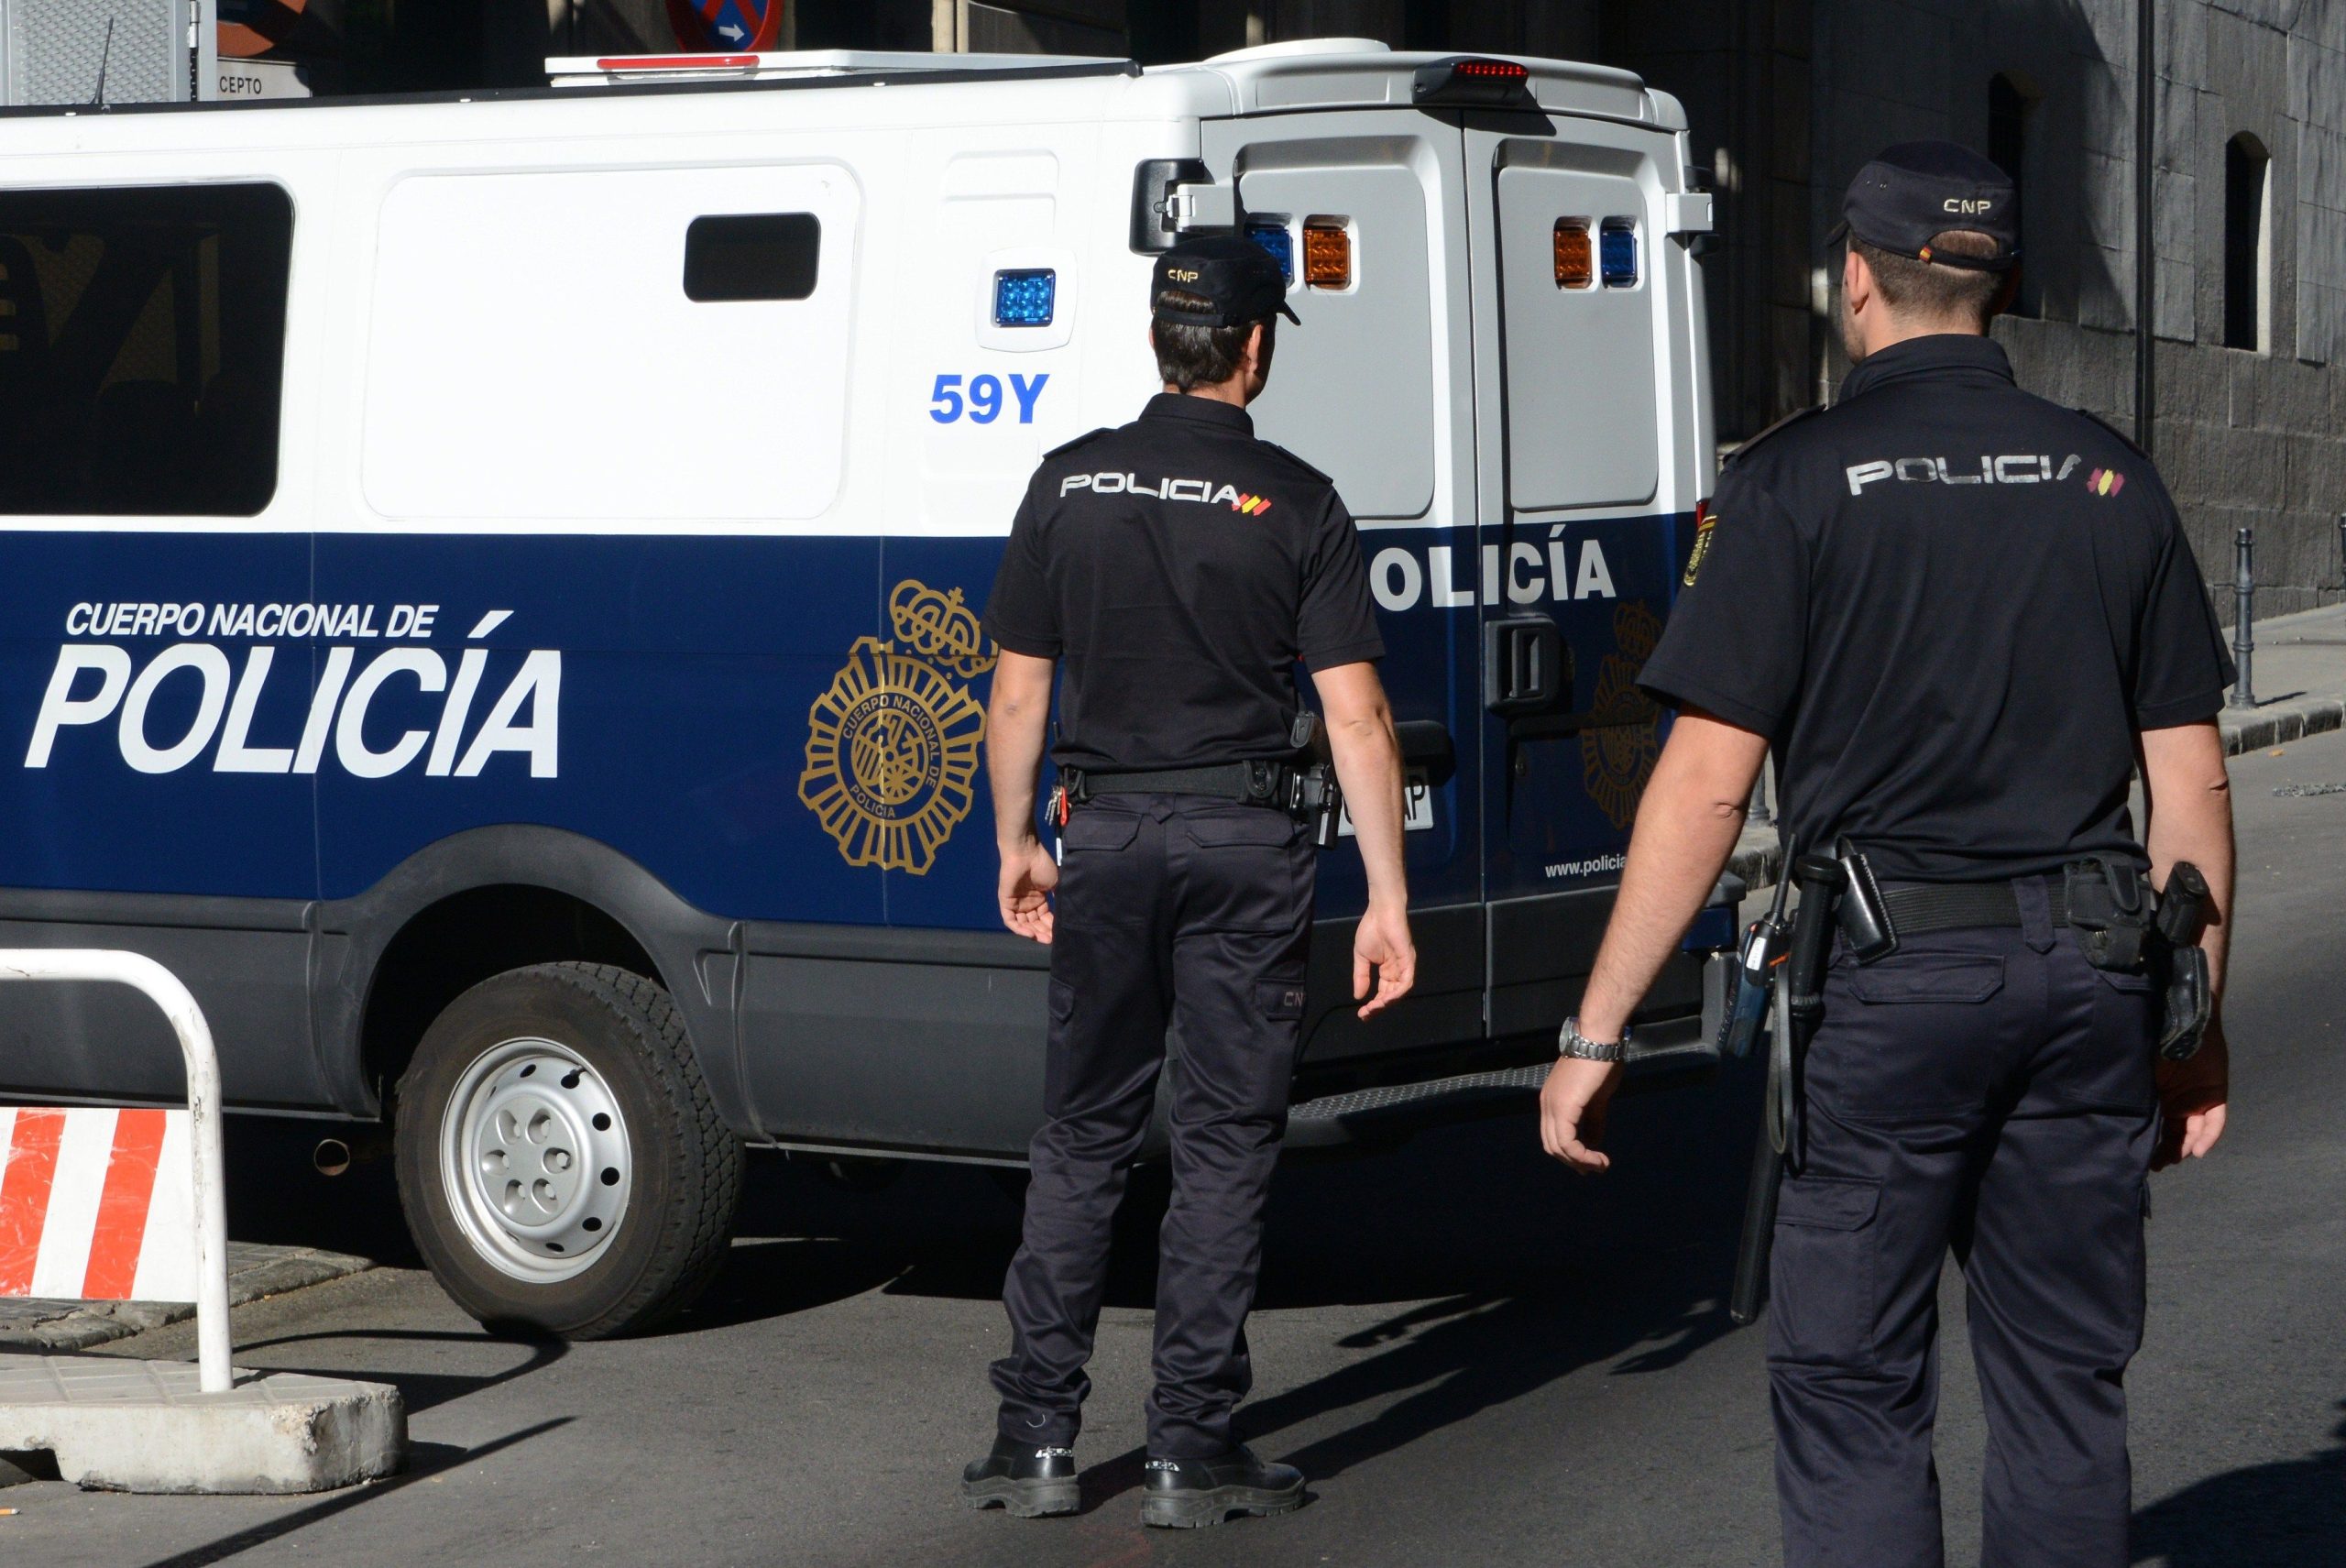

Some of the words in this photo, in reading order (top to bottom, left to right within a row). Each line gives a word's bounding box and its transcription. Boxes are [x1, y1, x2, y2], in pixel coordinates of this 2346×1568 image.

[219, 76, 262, 94] CEPTO
[1944, 198, 1991, 215] CNP
[1168, 269, 1199, 283] CNP
[929, 373, 1050, 424] 59Y
[1059, 472, 1242, 507] POLICIA
[1369, 523, 1617, 611] OLICÍA
[66, 602, 204, 636] CUERPO
[207, 603, 380, 638] NACIONAL
[385, 605, 439, 638] DE
[24, 610, 562, 778] POLICÍA
[843, 695, 890, 740] CUERPO
[893, 696, 940, 761] NACIONAL
[926, 766, 940, 788] DE
[850, 784, 895, 818] POLICIA
[1284, 992, 1304, 1007] CN
